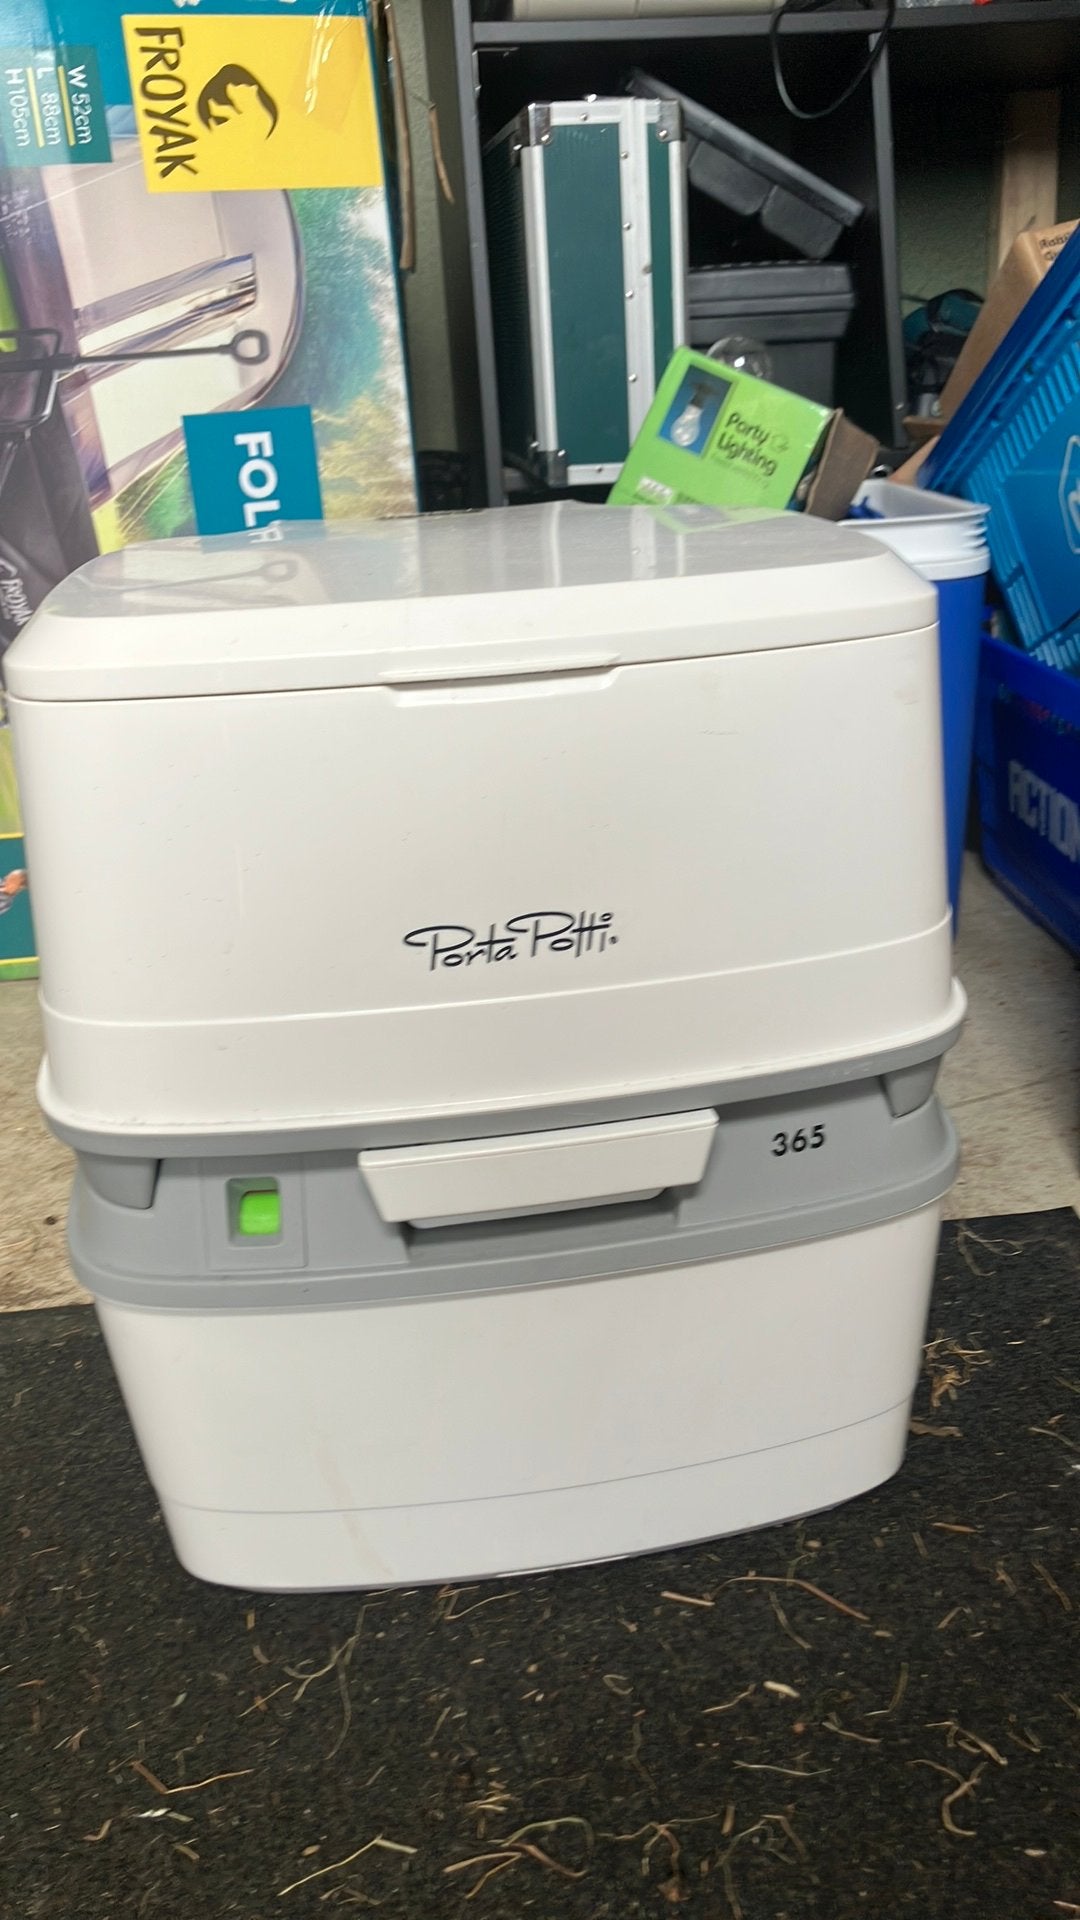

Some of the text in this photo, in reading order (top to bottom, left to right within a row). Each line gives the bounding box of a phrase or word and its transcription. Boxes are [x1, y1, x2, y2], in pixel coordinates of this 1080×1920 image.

[36, 67, 55, 80] L
[8, 86, 31, 147] 105cm
[68, 64, 93, 144] W 52cm
[135, 26, 198, 179] FROYAK
[726, 412, 770, 446] Party
[717, 432, 778, 477] Lighting
[234, 431, 281, 528] FOL
[402, 924, 519, 972] Porta
[771, 1124, 826, 1157] 365
